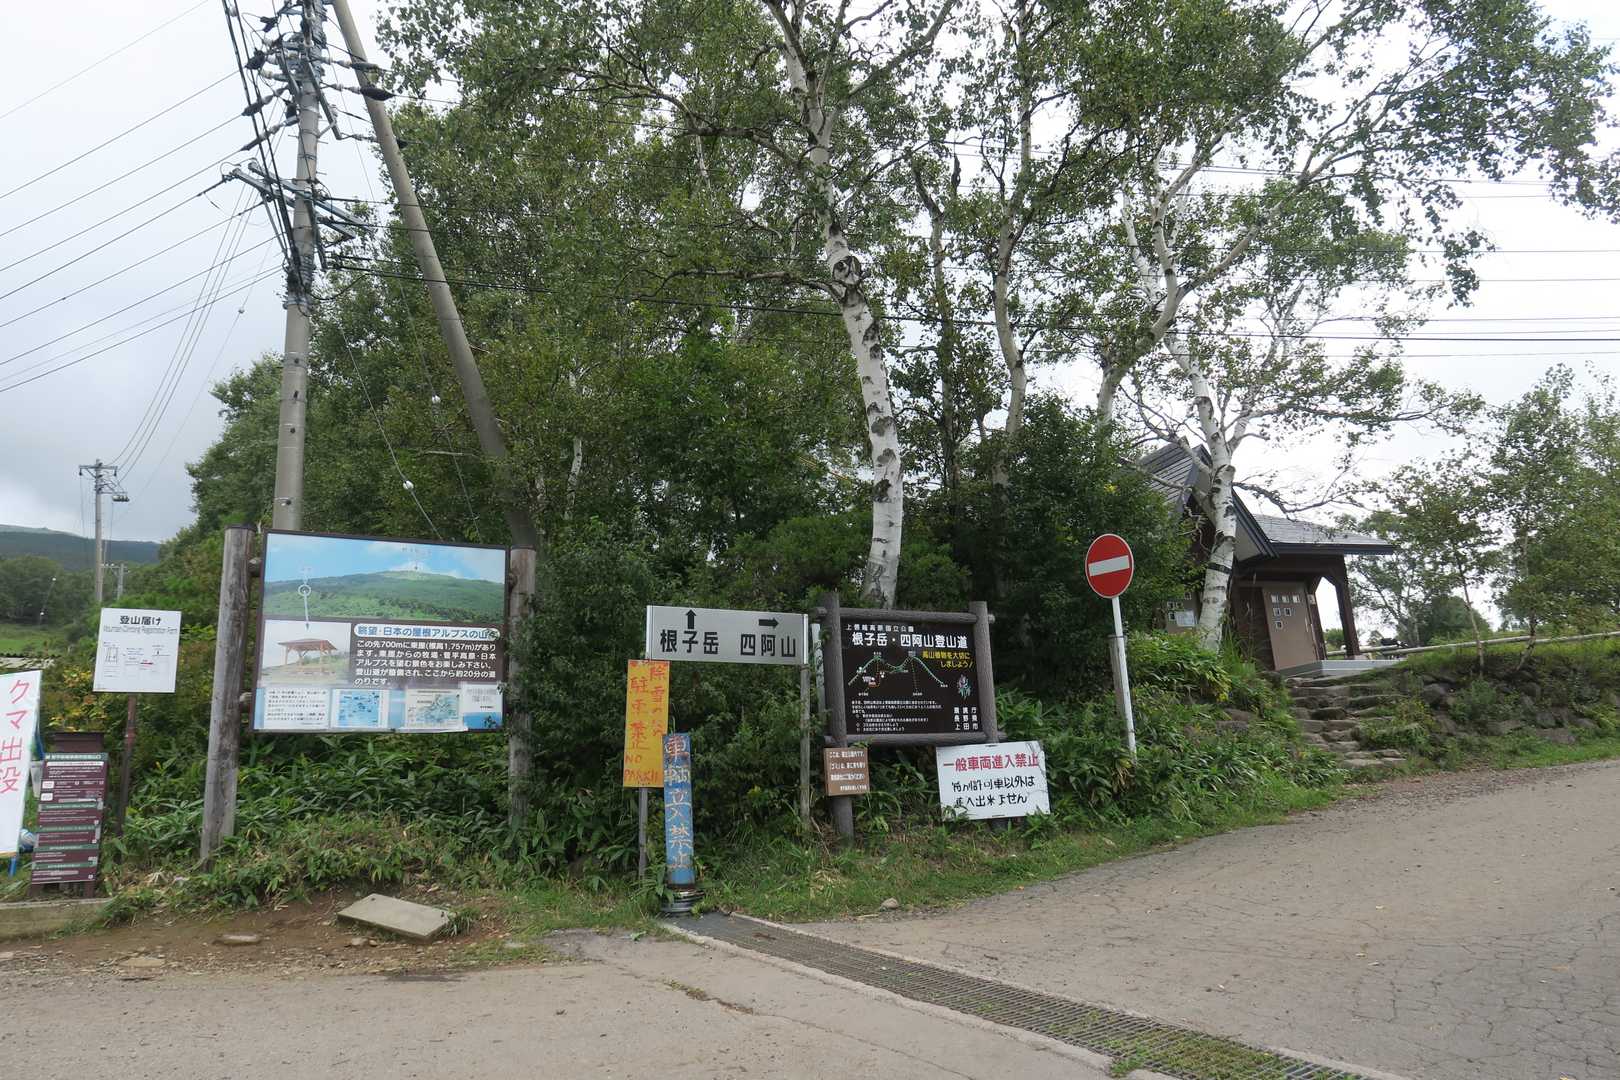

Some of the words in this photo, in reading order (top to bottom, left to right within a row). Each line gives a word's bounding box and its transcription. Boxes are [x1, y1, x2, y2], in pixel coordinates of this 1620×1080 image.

[119, 615, 162, 626] 登山届け
[357, 625, 498, 640] 眺望・日本の屋根アルプスの山
[851, 632, 968, 649] 根子岳・四阿山登山道
[660, 629, 720, 655] 根子岳
[740, 633, 796, 658] 四阿山
[955, 722, 979, 731] 上田市
[943, 752, 1040, 772] 一般車両進入禁止
